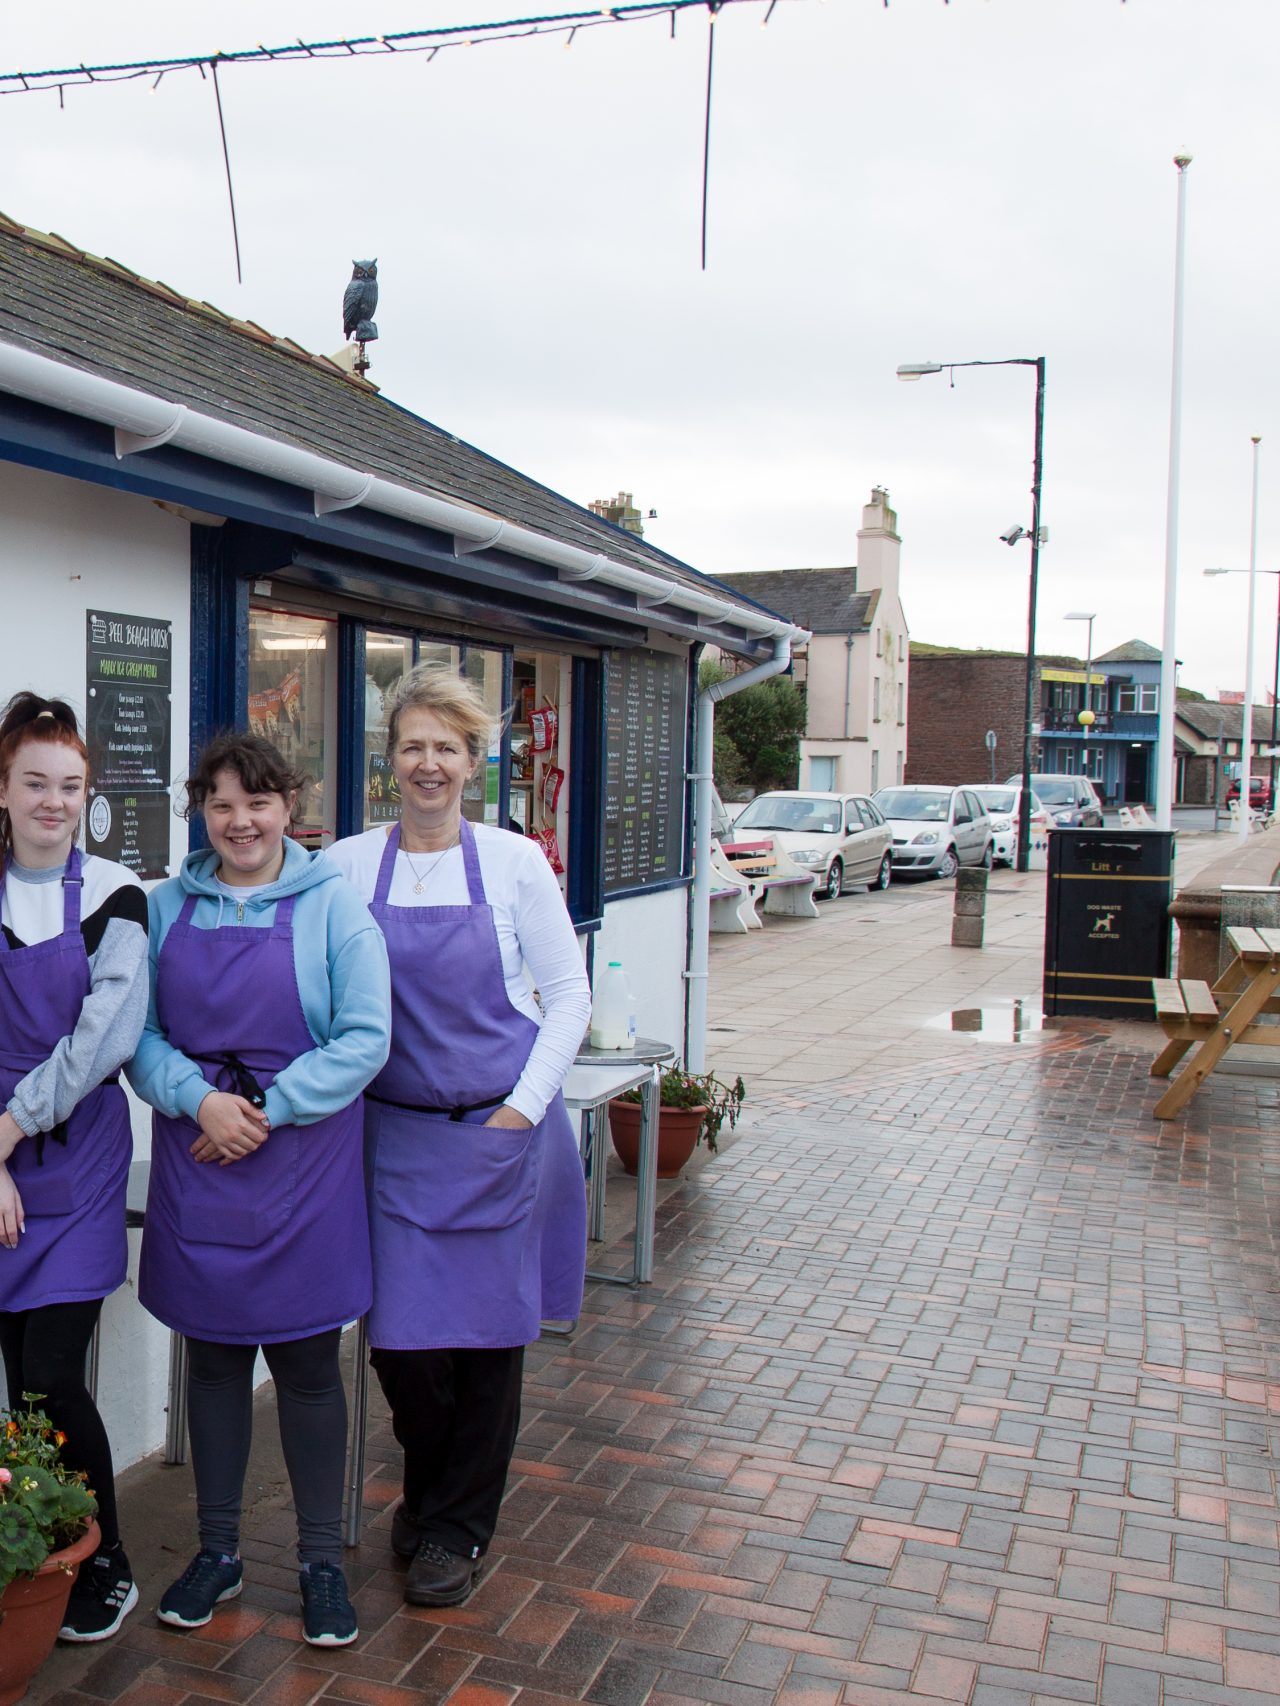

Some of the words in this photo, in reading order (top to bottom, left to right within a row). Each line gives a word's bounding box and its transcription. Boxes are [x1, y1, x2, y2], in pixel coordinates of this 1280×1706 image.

[108, 621, 124, 643] PEEL
[125, 624, 150, 649] BEACH
[150, 628, 169, 650] KIOSK
[117, 661, 125, 676] ICE
[126, 662, 143, 679] CREAM
[143, 663, 158, 680] MENU
